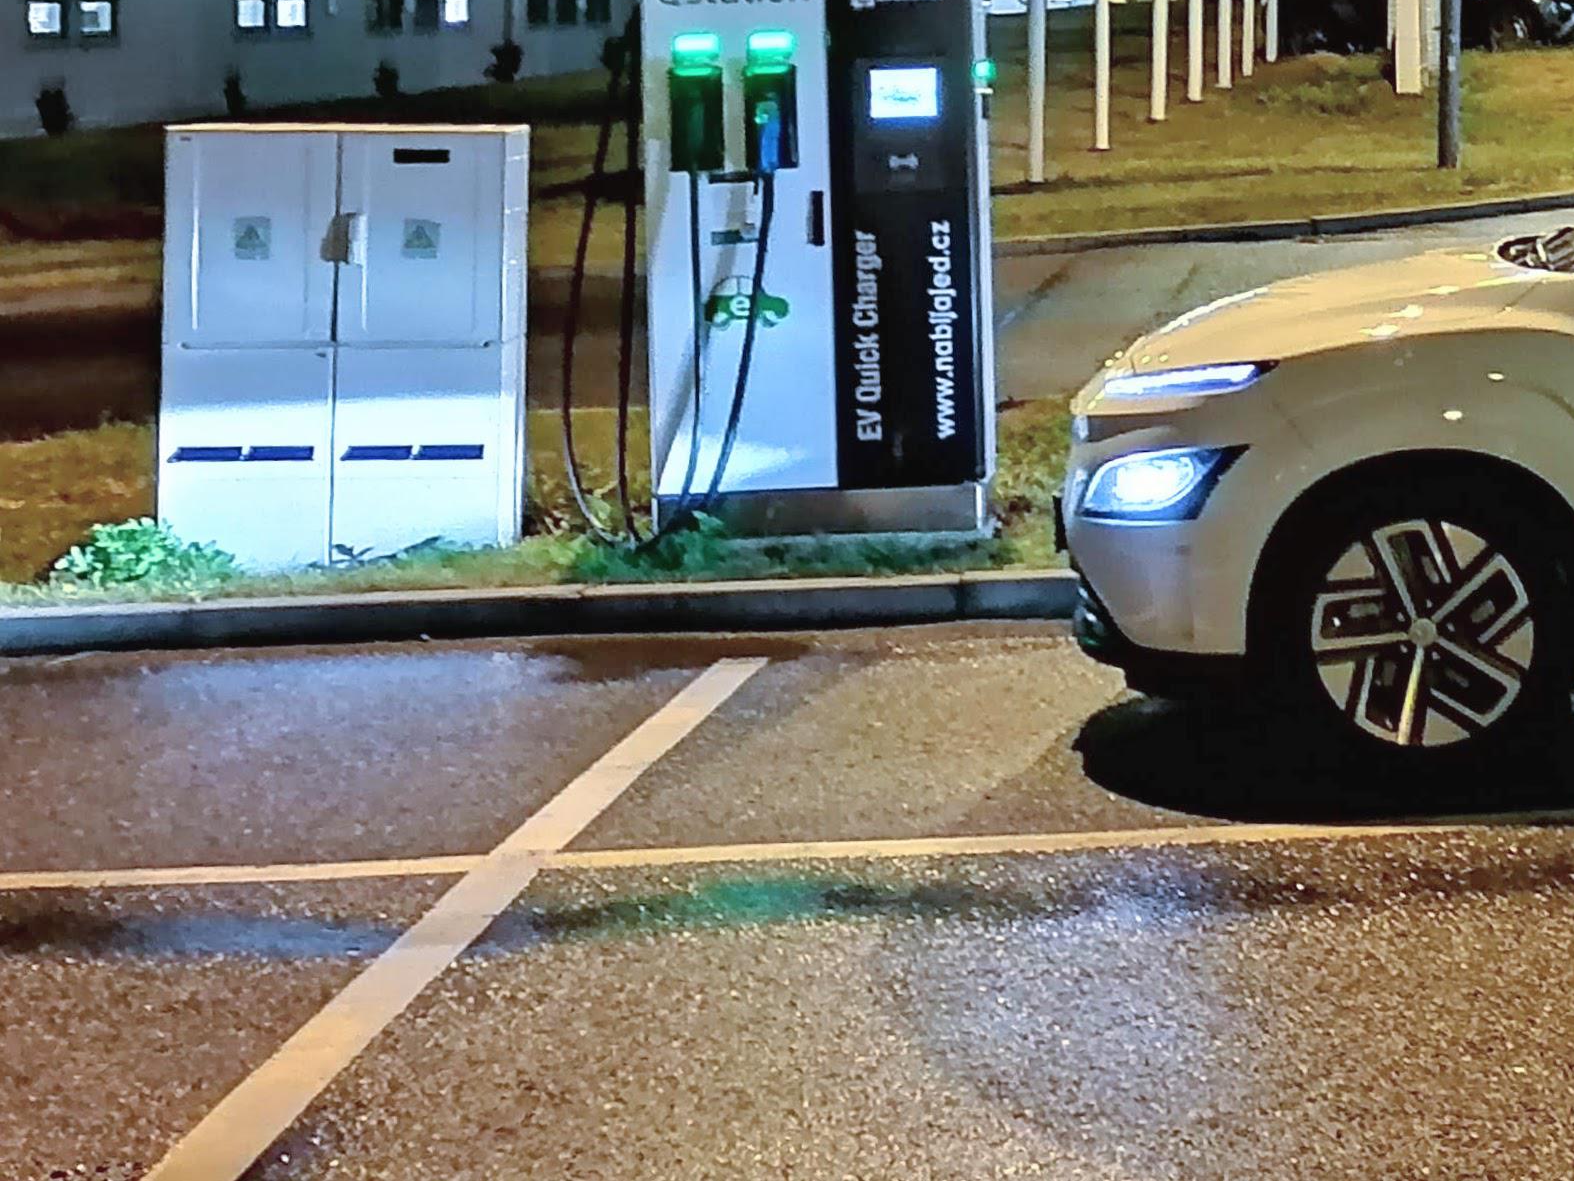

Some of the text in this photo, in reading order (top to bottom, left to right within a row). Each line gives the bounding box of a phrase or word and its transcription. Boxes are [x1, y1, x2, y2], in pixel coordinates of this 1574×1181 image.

[852, 229, 883, 441] EV Quick Charger
